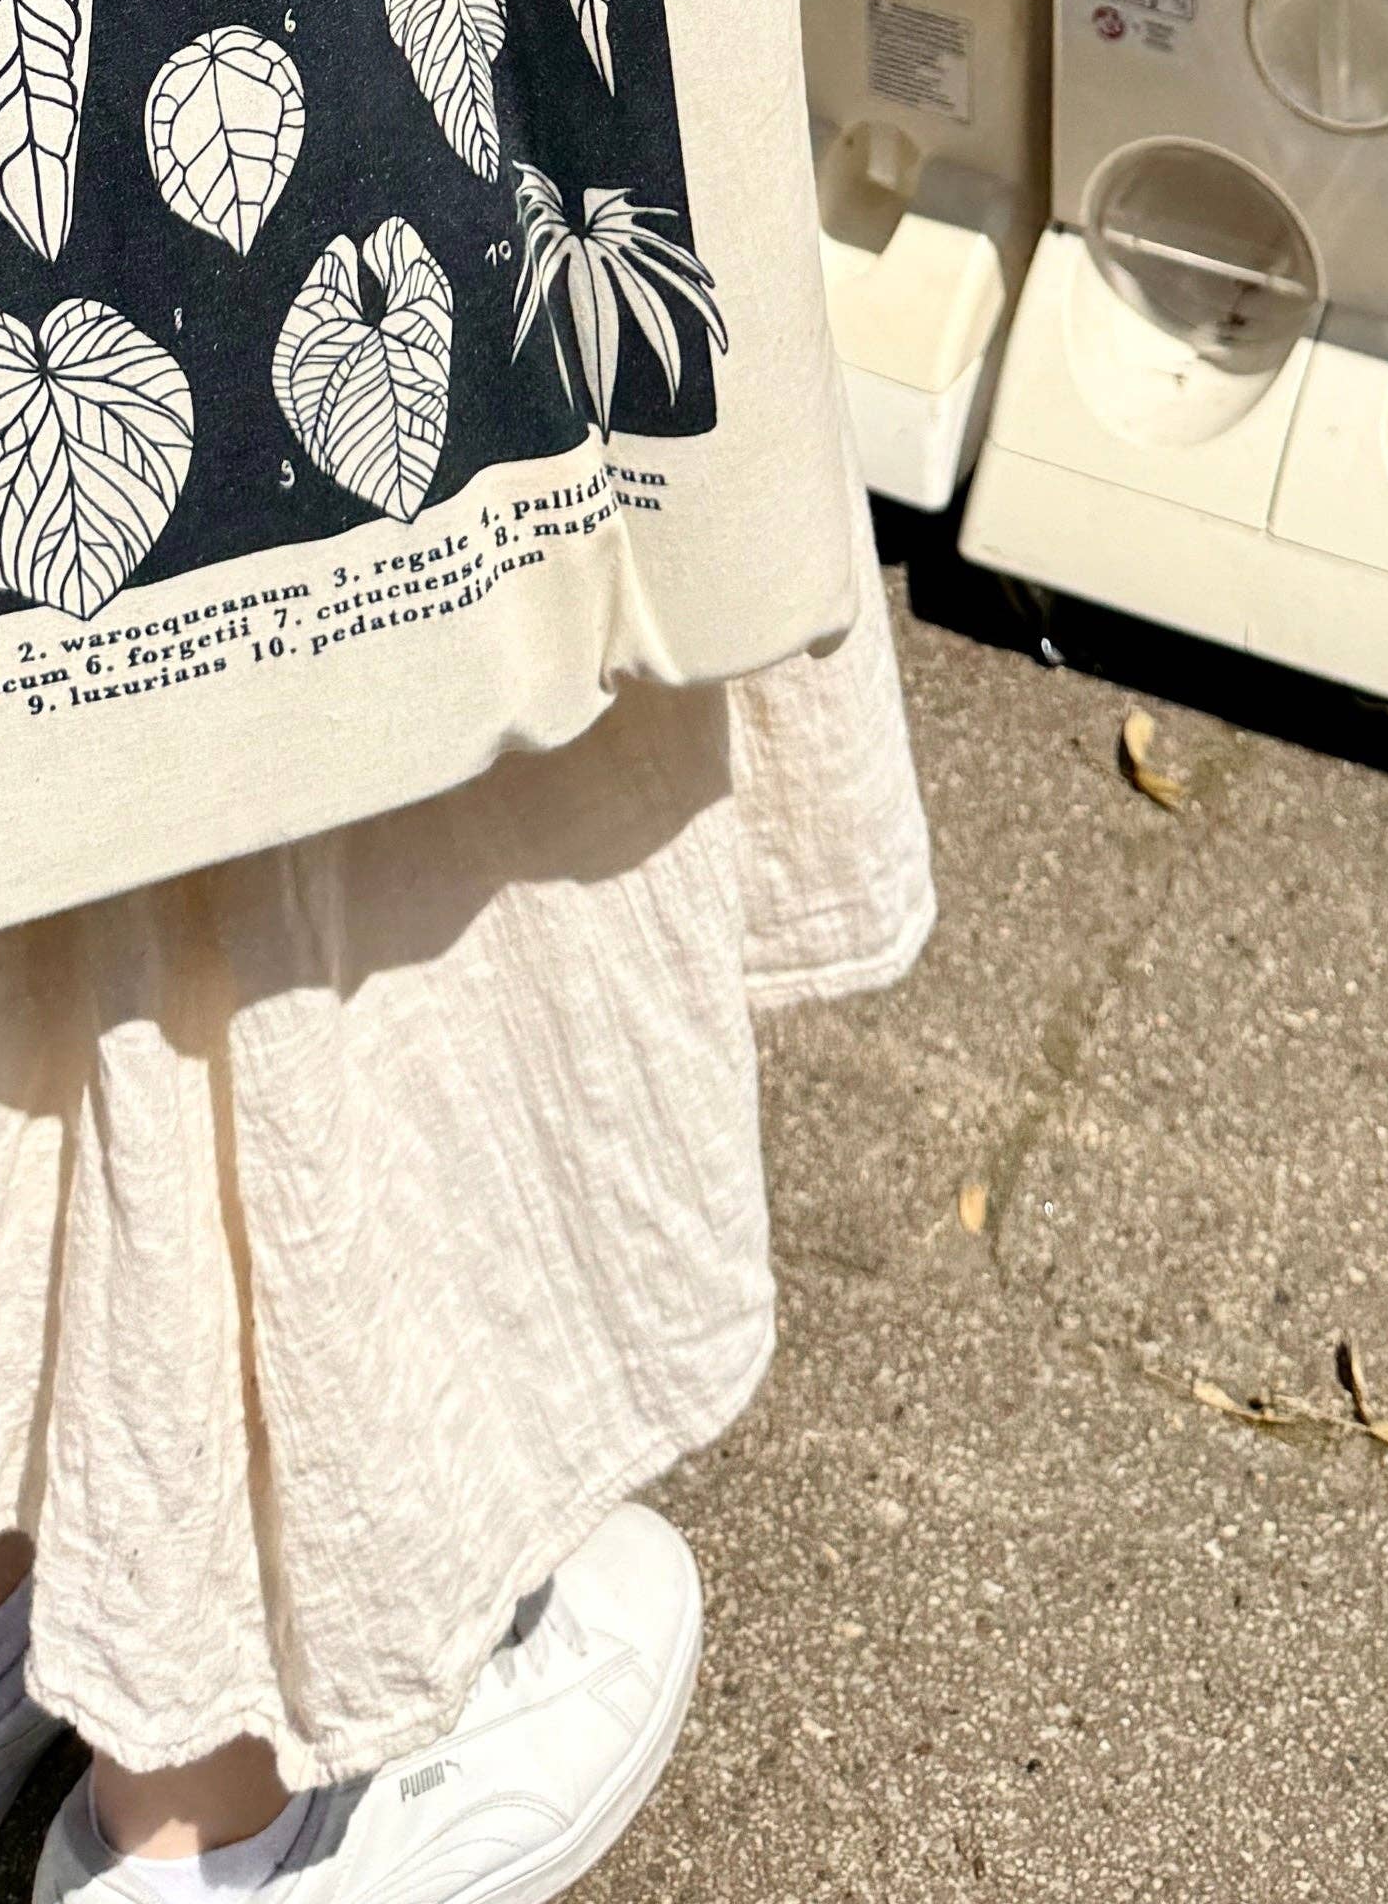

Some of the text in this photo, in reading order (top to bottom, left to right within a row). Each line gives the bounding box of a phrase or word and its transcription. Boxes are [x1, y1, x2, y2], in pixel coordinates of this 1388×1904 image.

[284, 7, 296, 34] 6
[485, 239, 512, 267] 10
[17, 641, 48, 665] 2.
[59, 581, 312, 654] warocqueanum
[333, 565, 361, 588] 3.
[373, 531, 470, 579] regale
[85, 653, 115, 677] 6.
[126, 616, 252, 670] forgetii
[273, 607, 303, 630] 7.
[316, 551, 484, 622] cutucuense
[493, 525, 521, 548] 8.
[27, 694, 58, 716] 9.
[70, 655, 228, 707] luxurians
[251, 636, 297, 663] 10.
[399, 1760, 446, 1803] PUMA
